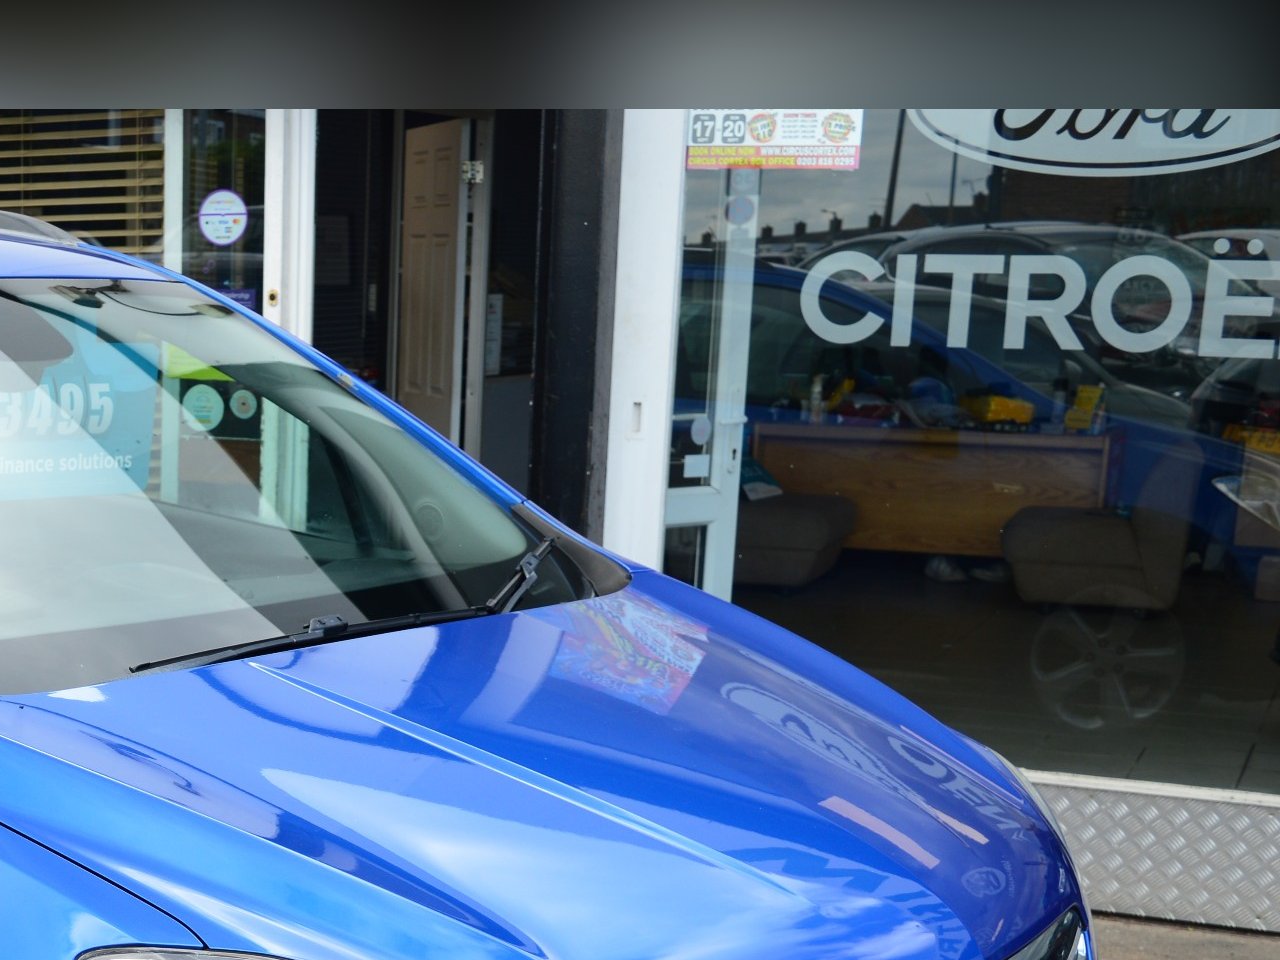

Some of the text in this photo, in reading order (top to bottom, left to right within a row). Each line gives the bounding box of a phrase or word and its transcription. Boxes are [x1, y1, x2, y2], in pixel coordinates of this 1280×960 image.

[693, 121, 715, 138] 17
[722, 121, 745, 138] 20
[800, 238, 1280, 360] CITROË
[59, 452, 133, 471] solutions
